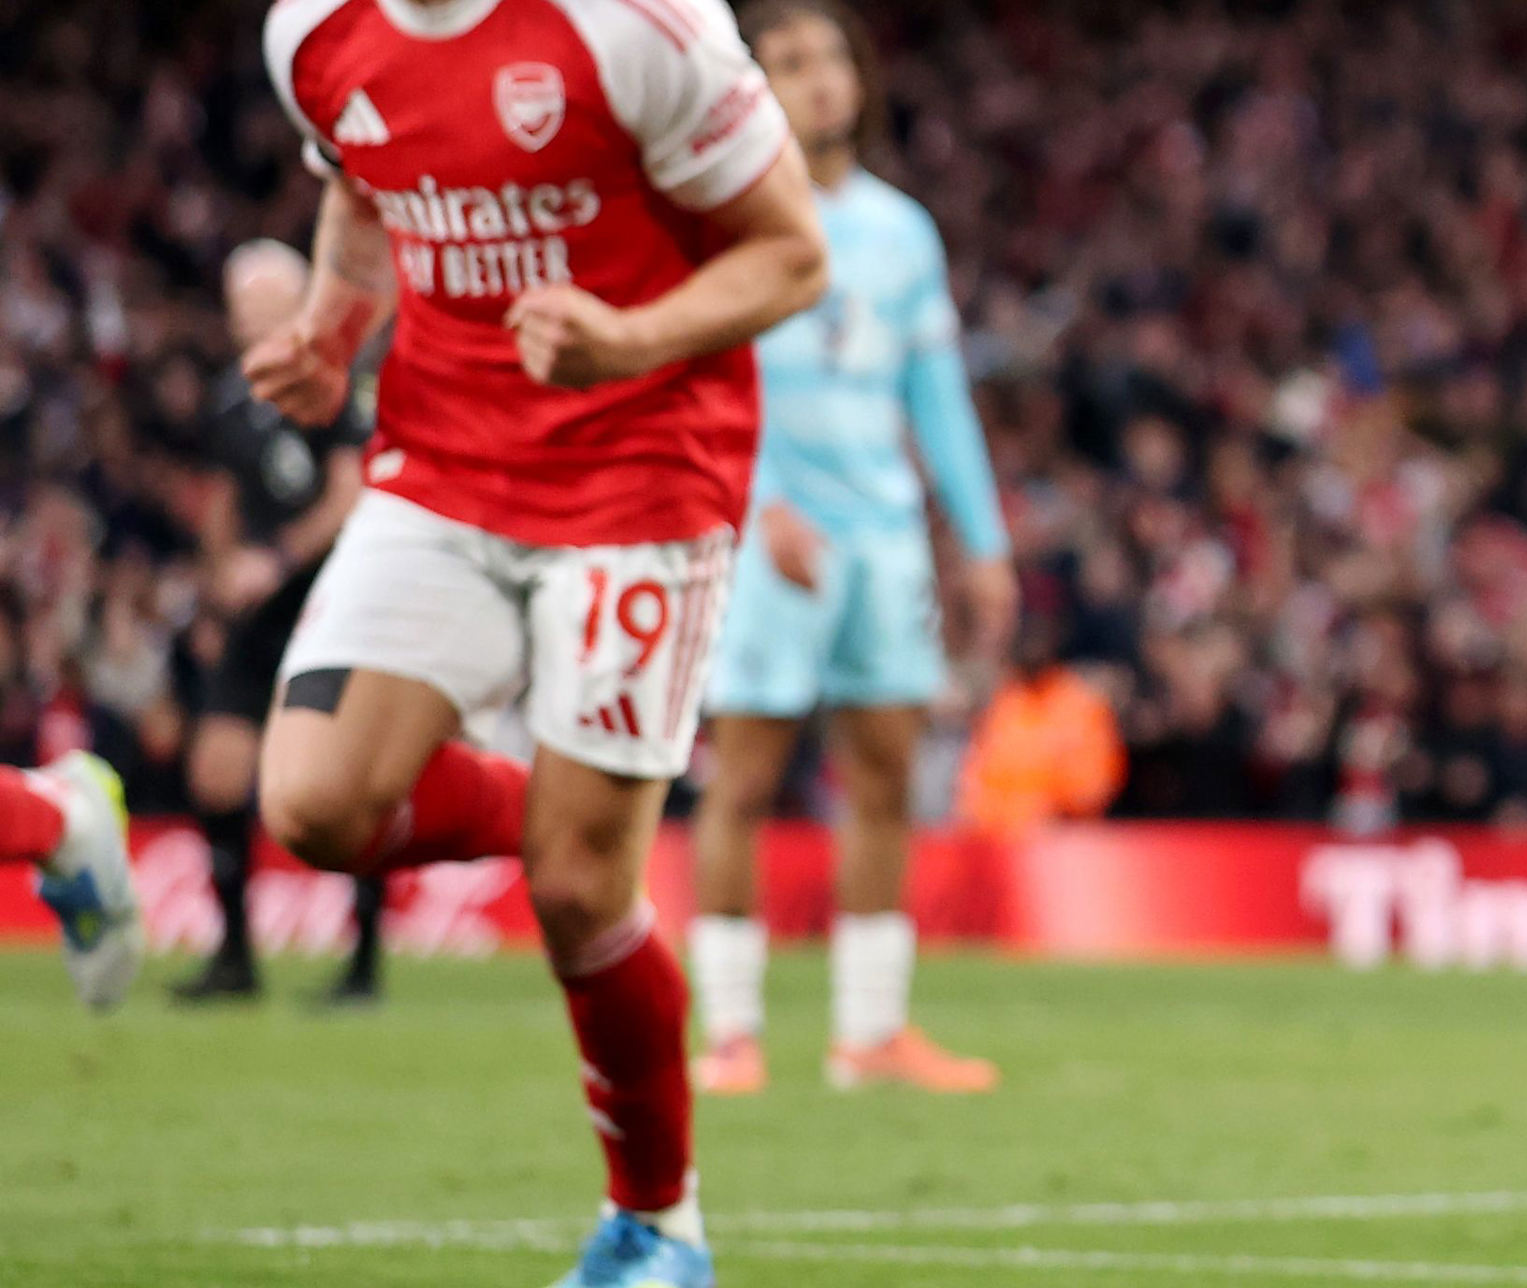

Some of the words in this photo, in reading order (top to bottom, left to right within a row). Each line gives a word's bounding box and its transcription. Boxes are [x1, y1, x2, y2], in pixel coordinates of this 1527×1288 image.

[374, 174, 601, 242] mirates
[443, 234, 572, 299] BETTER
[577, 567, 671, 679] 19
